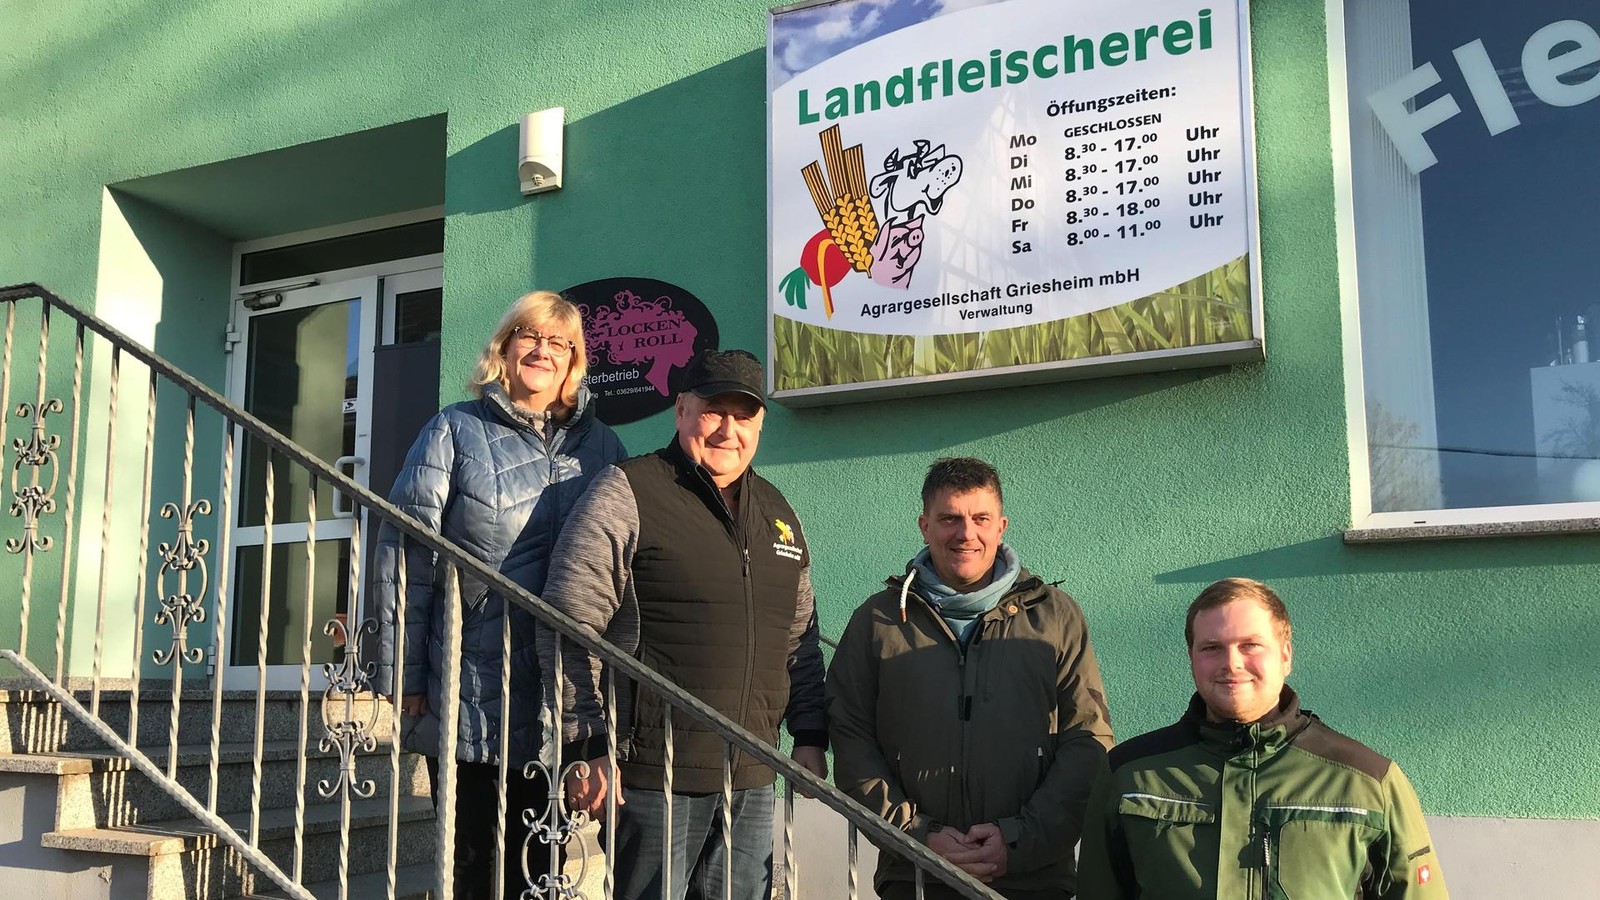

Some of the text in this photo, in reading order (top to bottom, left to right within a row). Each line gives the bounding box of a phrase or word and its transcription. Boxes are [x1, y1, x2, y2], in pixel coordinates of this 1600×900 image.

[798, 9, 1213, 125] Landfleischerei
[1046, 85, 1177, 117] Öffungszeiten:
[1009, 113, 1162, 148] Mo GESCHLOSSEN
[1010, 154, 1028, 170] Di
[1186, 126, 1219, 142] Uhr
[1010, 175, 1032, 191] Mi
[1187, 147, 1220, 163] Uhr
[1011, 198, 1035, 212] Do
[1187, 169, 1222, 185] Uhr
[1012, 219, 1029, 233] Fr
[1188, 191, 1223, 207] Uhr
[1012, 240, 1032, 254] Sa
[1189, 213, 1224, 229] Uhr
[860, 268, 1140, 318] Agrargesellschaft Griesheim mbH
[958, 301, 1033, 321] Verwaltung
[607, 318, 682, 338] LOCKEN
[634, 333, 683, 348] ROLL
